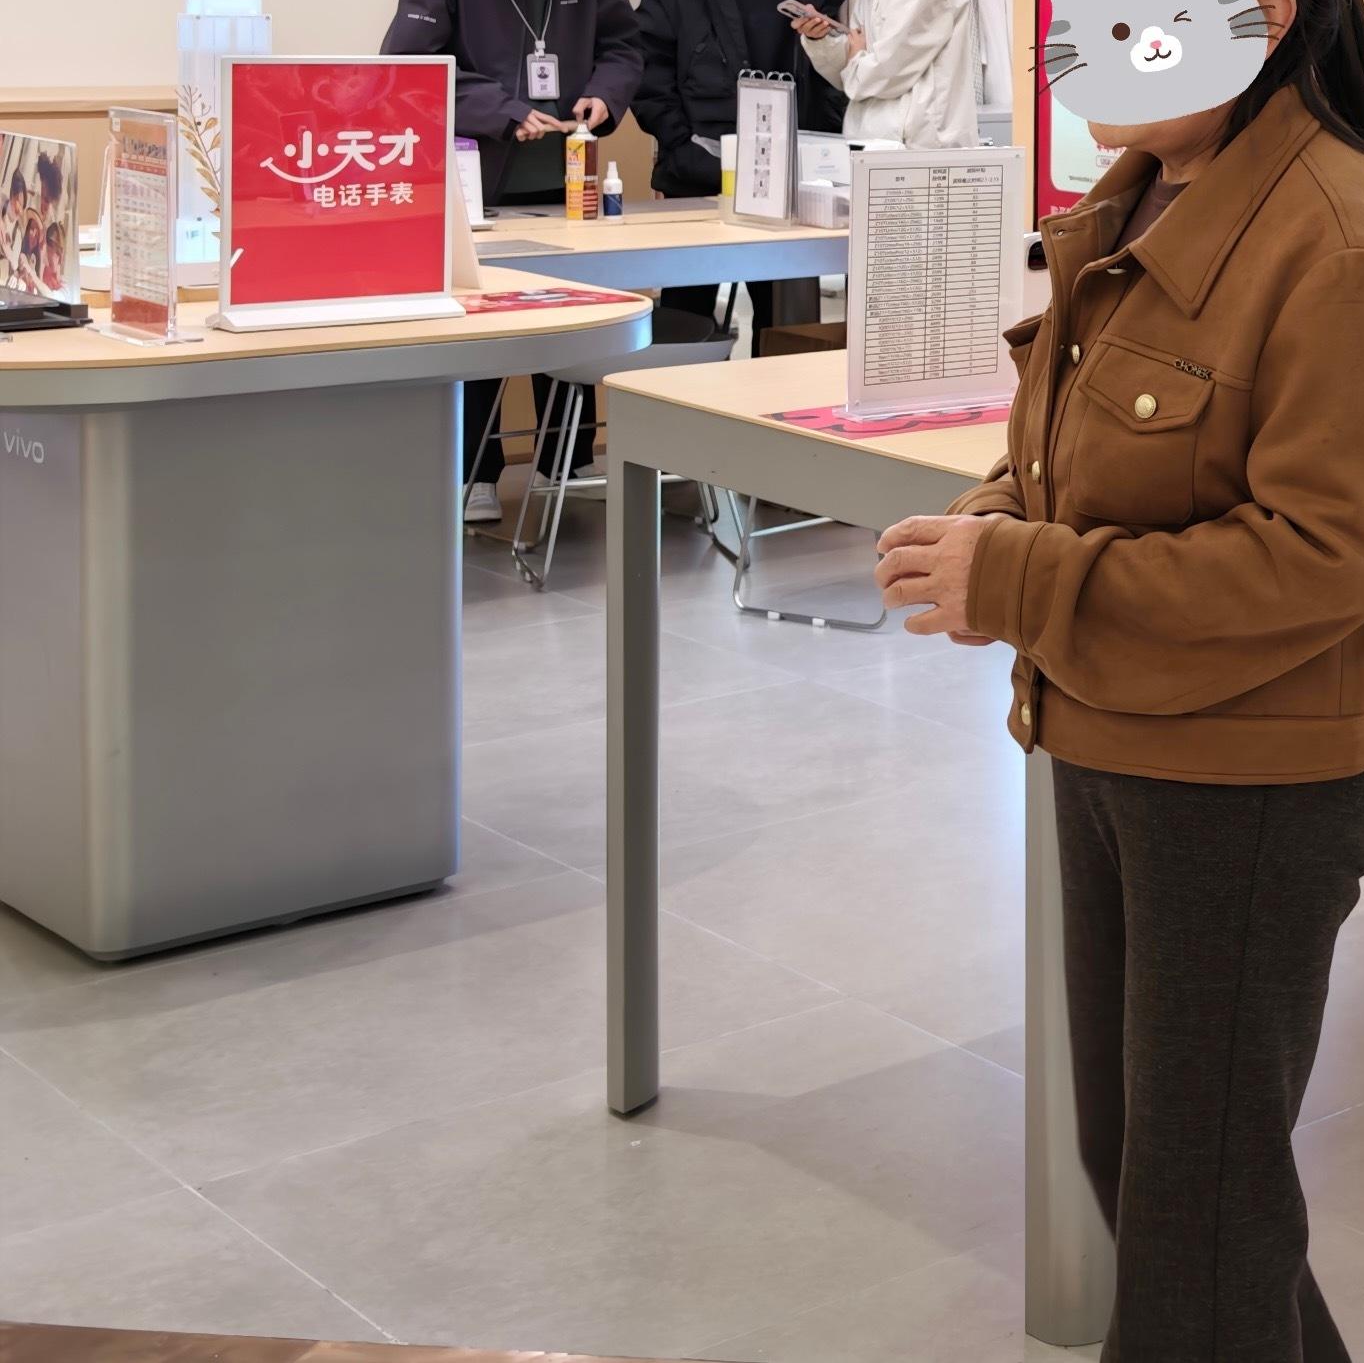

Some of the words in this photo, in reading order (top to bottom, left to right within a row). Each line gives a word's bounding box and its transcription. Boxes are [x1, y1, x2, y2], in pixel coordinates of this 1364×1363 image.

[284, 127, 420, 171] 小天才
[313, 182, 415, 208] 电话手表
[3, 429, 45, 463] vivo
